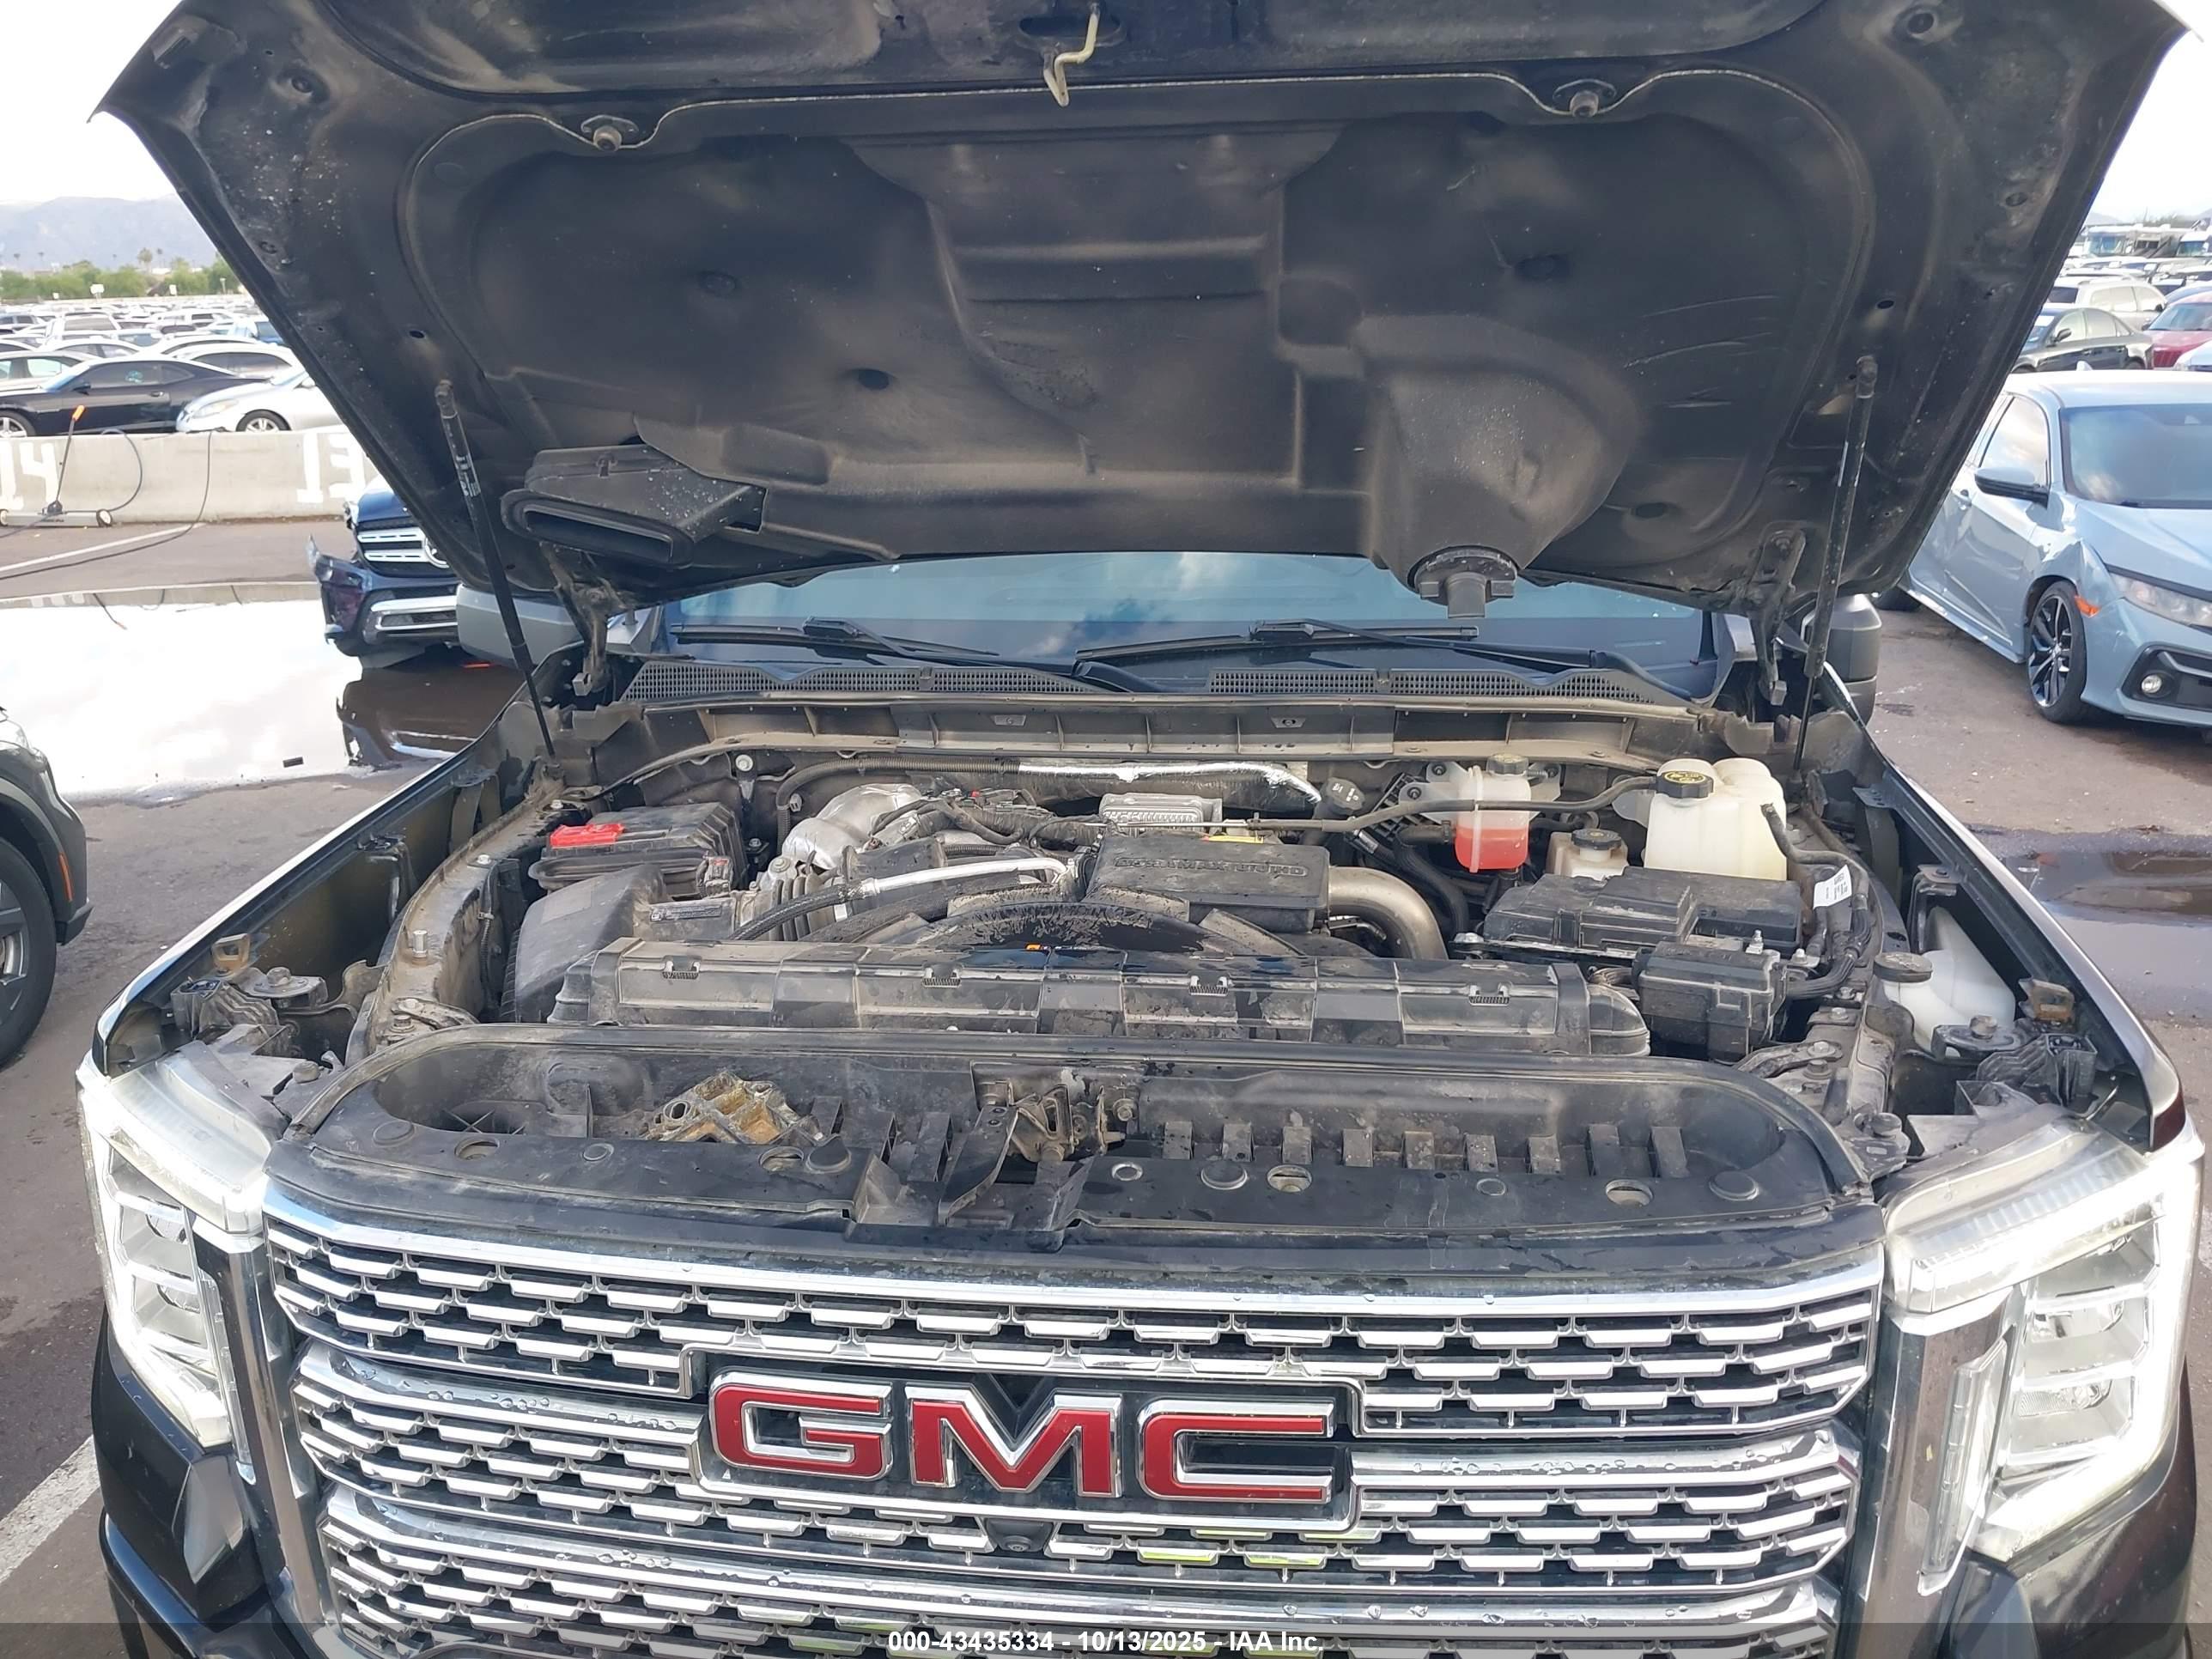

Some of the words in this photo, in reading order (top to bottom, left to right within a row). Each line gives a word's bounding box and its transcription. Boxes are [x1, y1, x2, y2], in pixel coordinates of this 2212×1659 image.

[0, 439, 60, 510] 14
[296, 432, 367, 503] 13
[709, 1372, 1335, 1504] GMC
